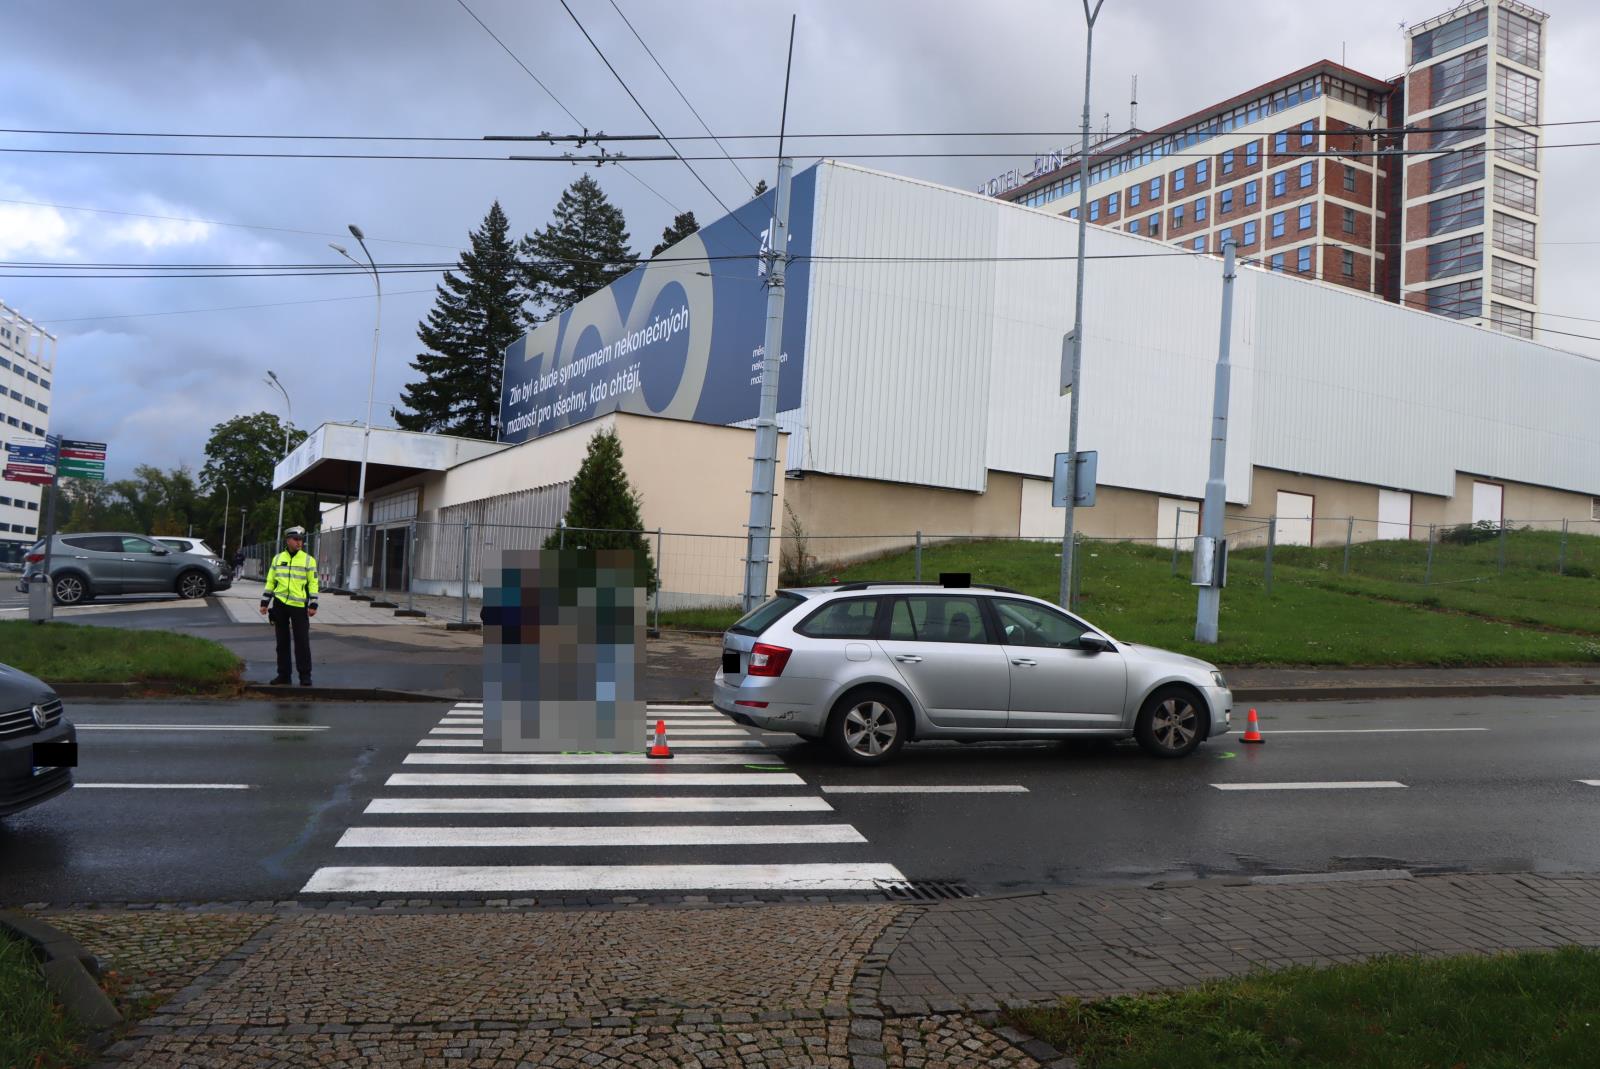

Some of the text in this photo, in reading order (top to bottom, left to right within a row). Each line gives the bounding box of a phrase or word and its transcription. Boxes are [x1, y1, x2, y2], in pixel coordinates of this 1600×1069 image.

[977, 167, 1020, 198] HOTEL
[509, 305, 689, 406] Zlín byl a bude synonymem nekonečných
[538, 404, 551, 428] pro
[552, 391, 588, 418] všechny,
[589, 379, 608, 405] kdo
[609, 361, 642, 395] chtějí.
